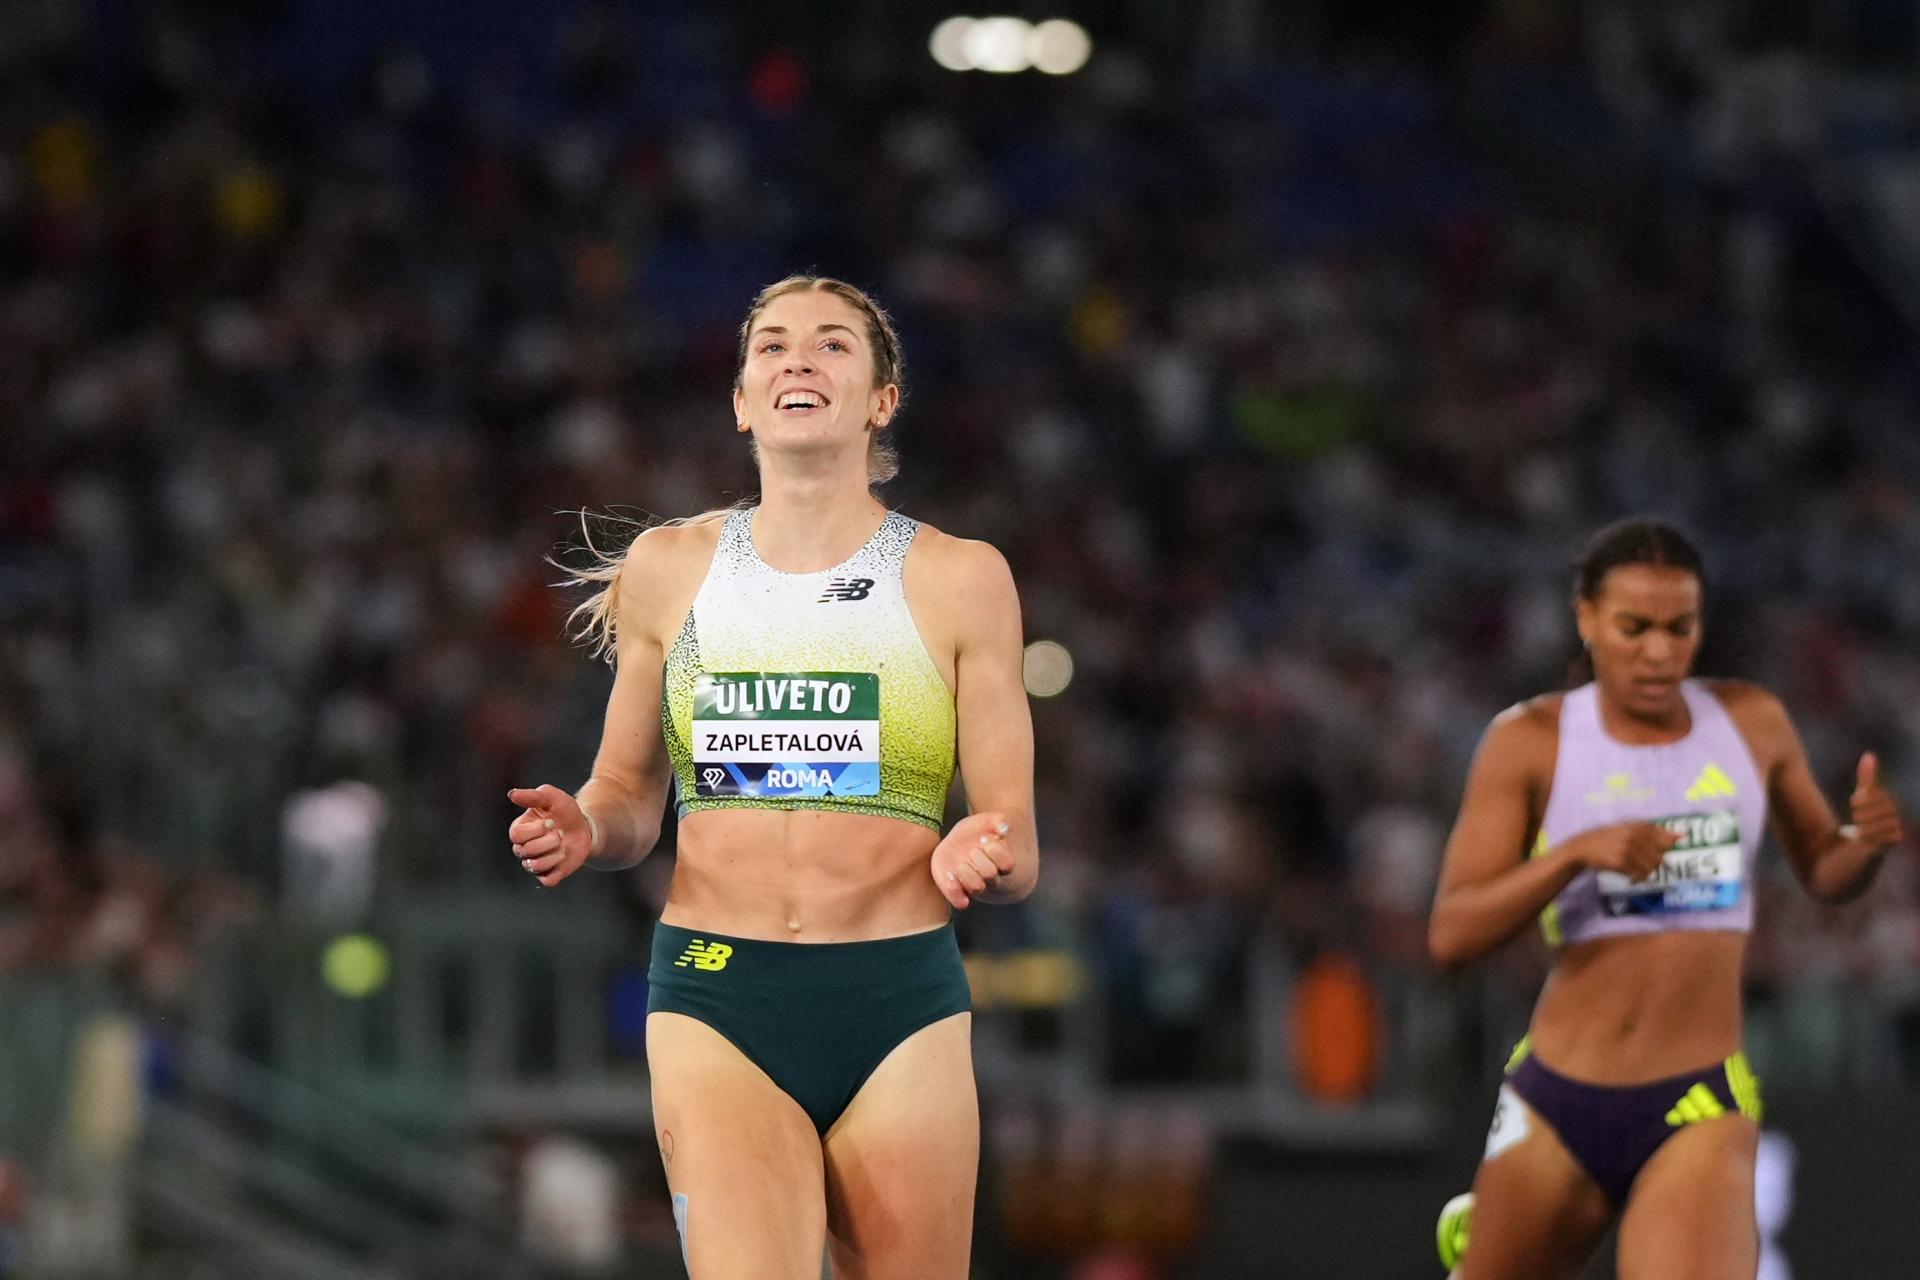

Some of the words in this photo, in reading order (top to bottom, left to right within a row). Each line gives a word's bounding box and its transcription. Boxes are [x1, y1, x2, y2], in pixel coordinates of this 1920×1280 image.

[716, 679, 852, 715] ULIVETO
[706, 729, 864, 752] ZAPLETALOVÁ
[767, 769, 833, 788] ROMA
